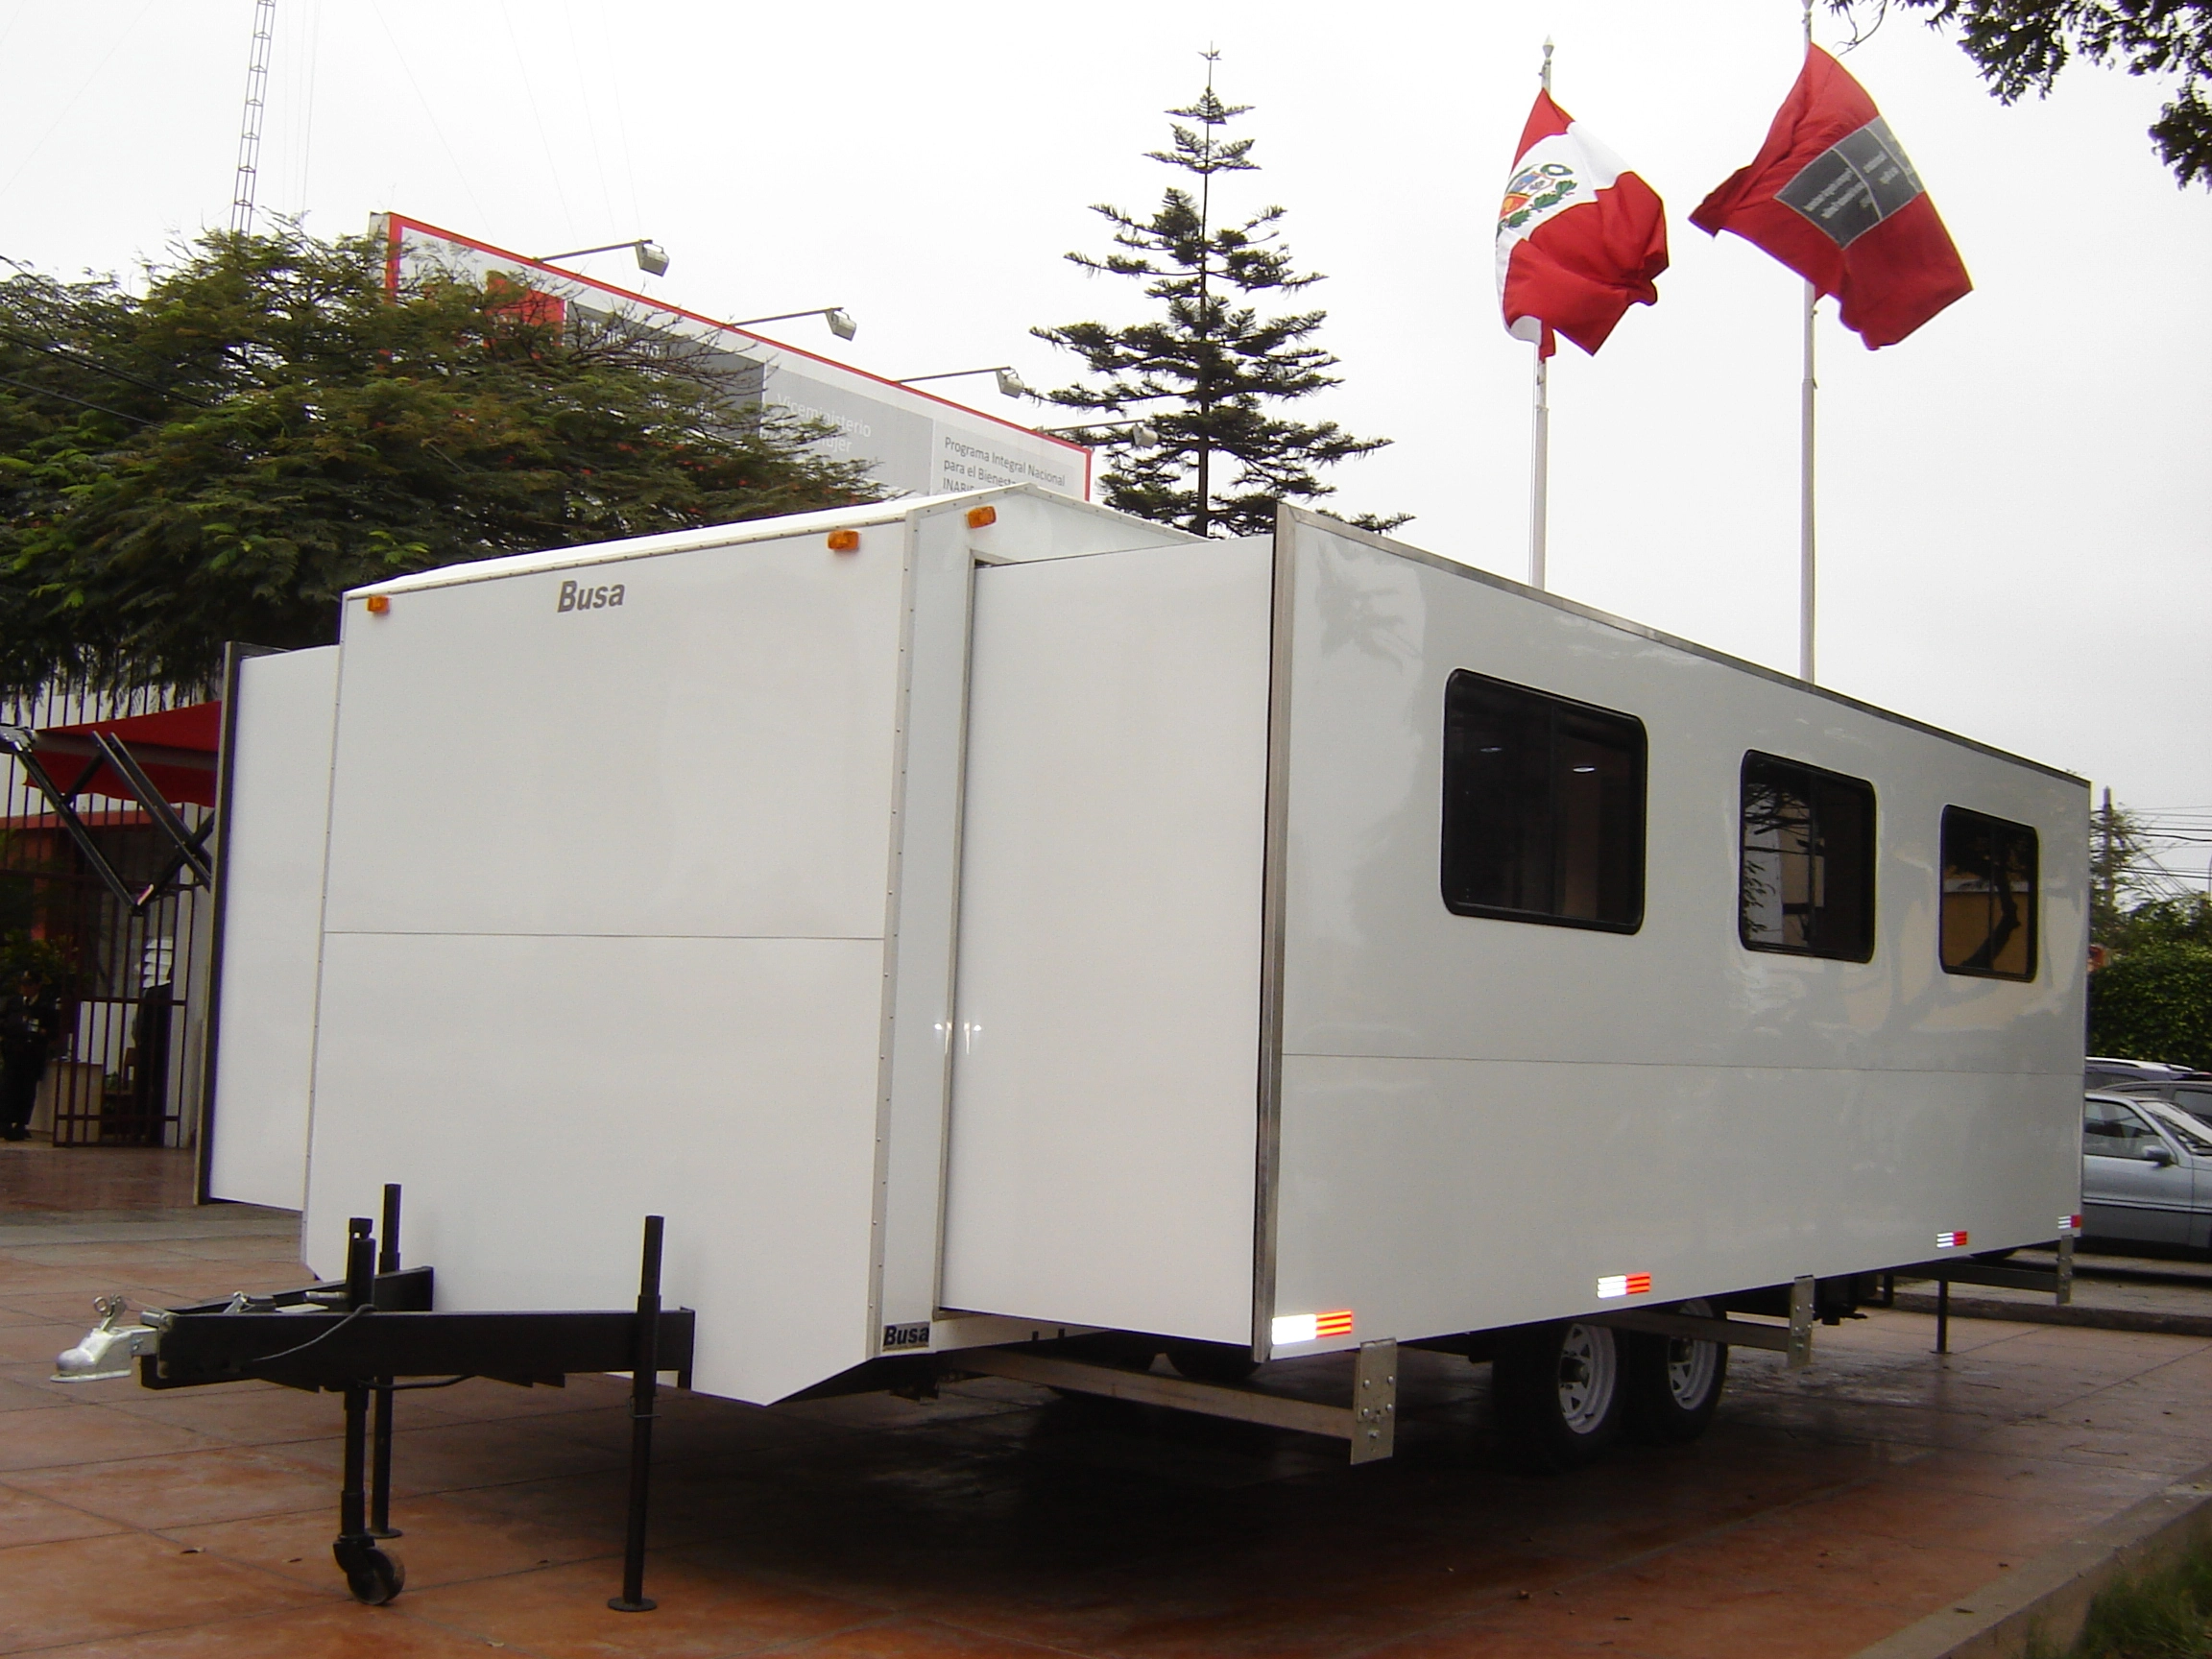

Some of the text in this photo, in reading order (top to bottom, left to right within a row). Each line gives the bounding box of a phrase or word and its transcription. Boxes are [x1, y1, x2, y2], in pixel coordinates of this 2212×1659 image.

[944, 459, 966, 475] para
[967, 466, 976, 478] el
[945, 436, 1066, 487] Programa Integral Nacional
[558, 580, 625, 613] Busa
[883, 1326, 929, 1346] Busa
